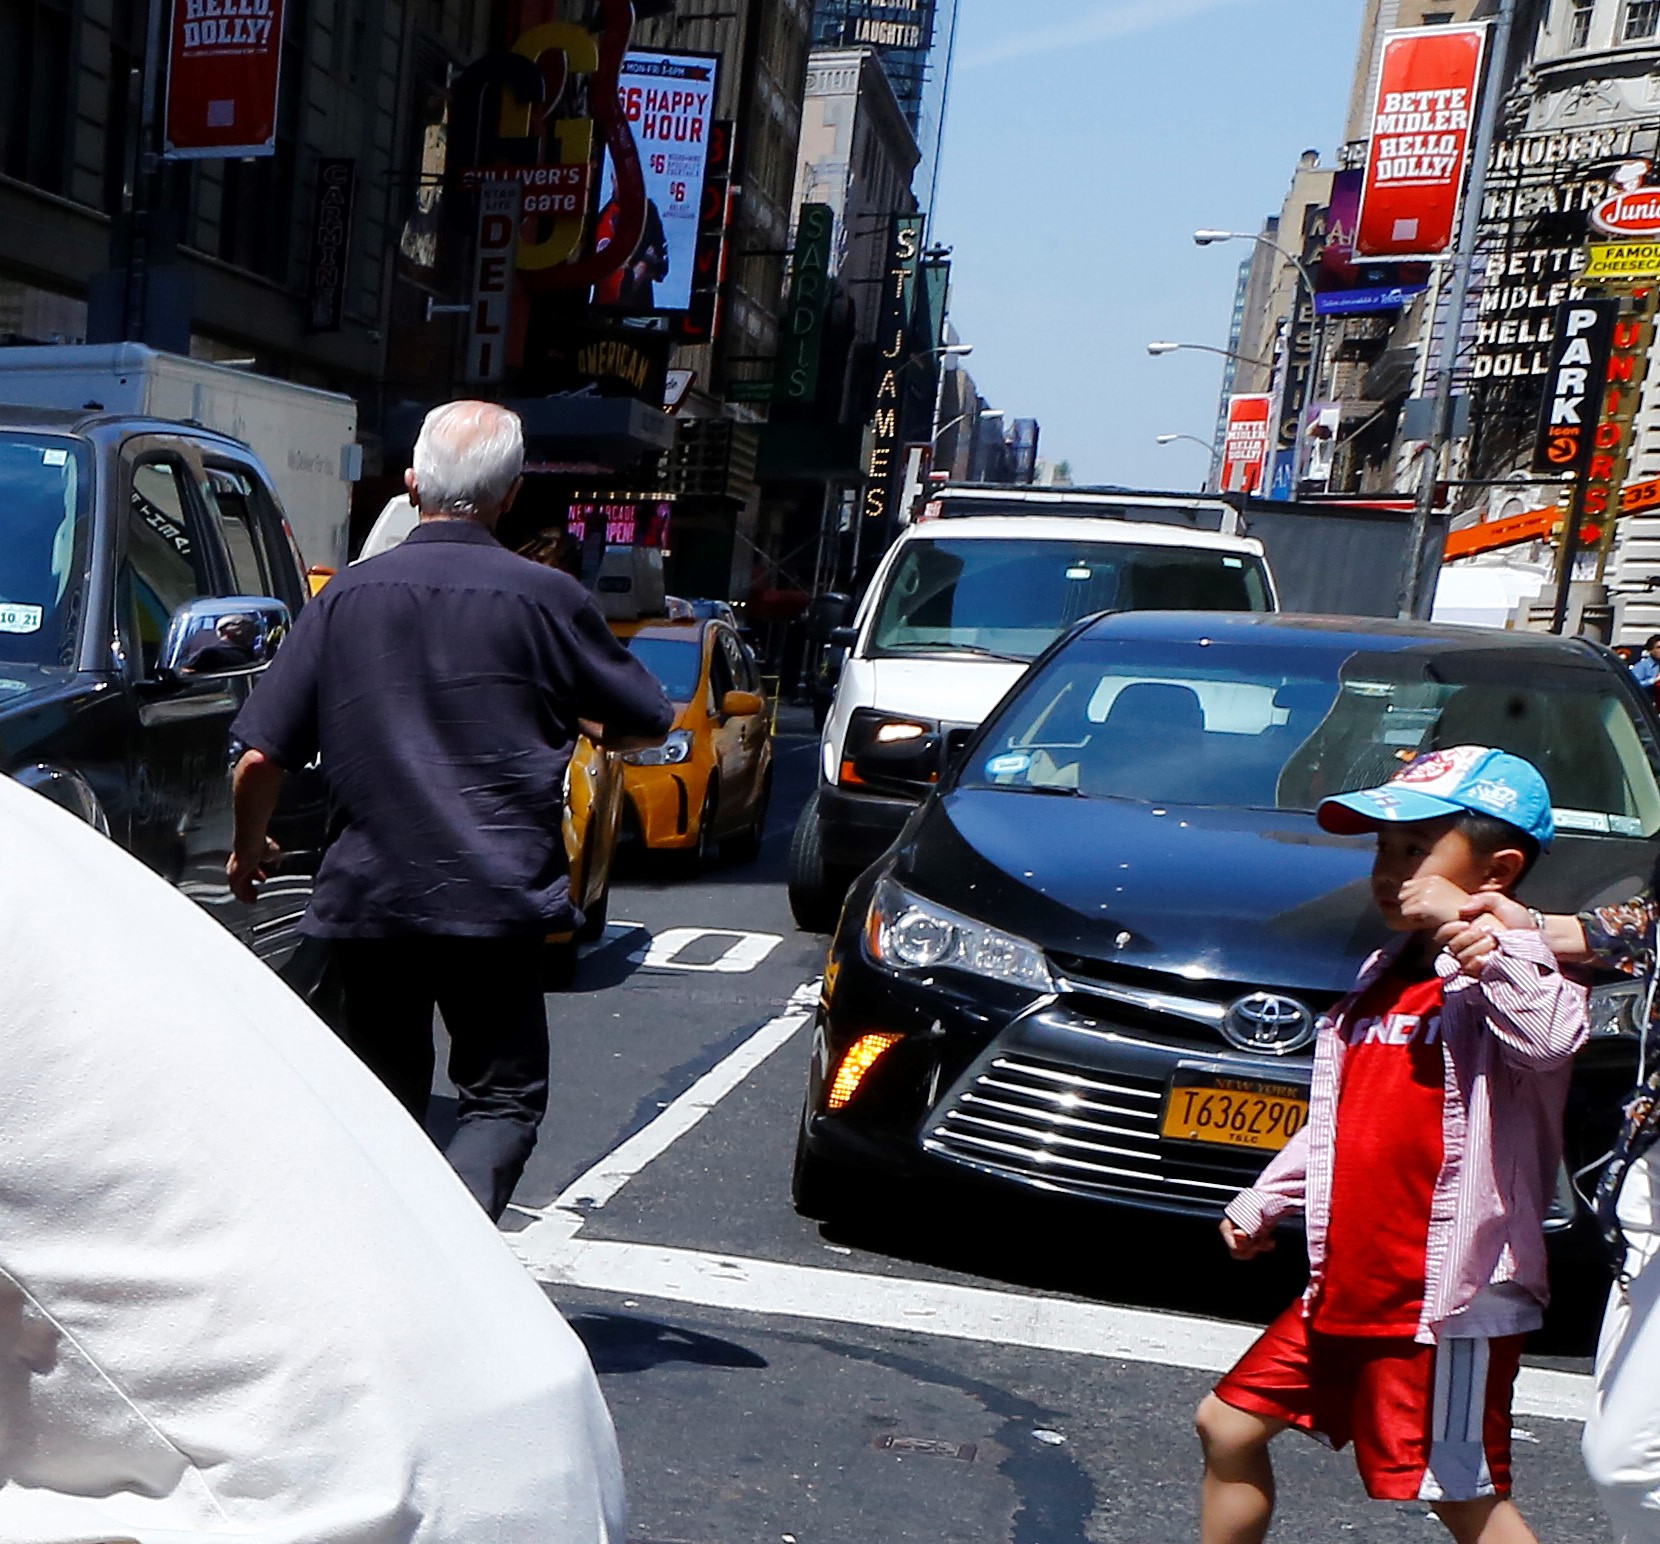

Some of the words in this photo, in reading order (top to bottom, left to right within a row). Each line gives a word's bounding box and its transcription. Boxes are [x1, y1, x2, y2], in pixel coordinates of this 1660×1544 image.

[183, 19, 272, 48] DOLLY!
[854, 18, 920, 47] LAUGHTER
[646, 89, 709, 115] HAPPY
[1383, 88, 1467, 113] BETTE
[642, 113, 703, 142] HOUR
[1375, 110, 1468, 135] MIDLER
[1380, 134, 1458, 159] HELLO,
[1486, 125, 1640, 172] HUBERT
[1376, 156, 1457, 181] DOLLY!
[1482, 177, 1618, 220] HEATR
[1485, 247, 1586, 278] BETTE
[475, 214, 512, 377] DELI
[1475, 317, 1555, 346] HELL
[1472, 352, 1551, 380] DOLL
[1550, 308, 1598, 425] PARK
[599, 504, 635, 521] RCADE
[0, 612, 16, 624] 10
[24, 613, 38, 626] 21
[1215, 1077, 1253, 1091] NEW
[1258, 1082, 1299, 1098] YORK
[1183, 1090, 1308, 1138] T636290
